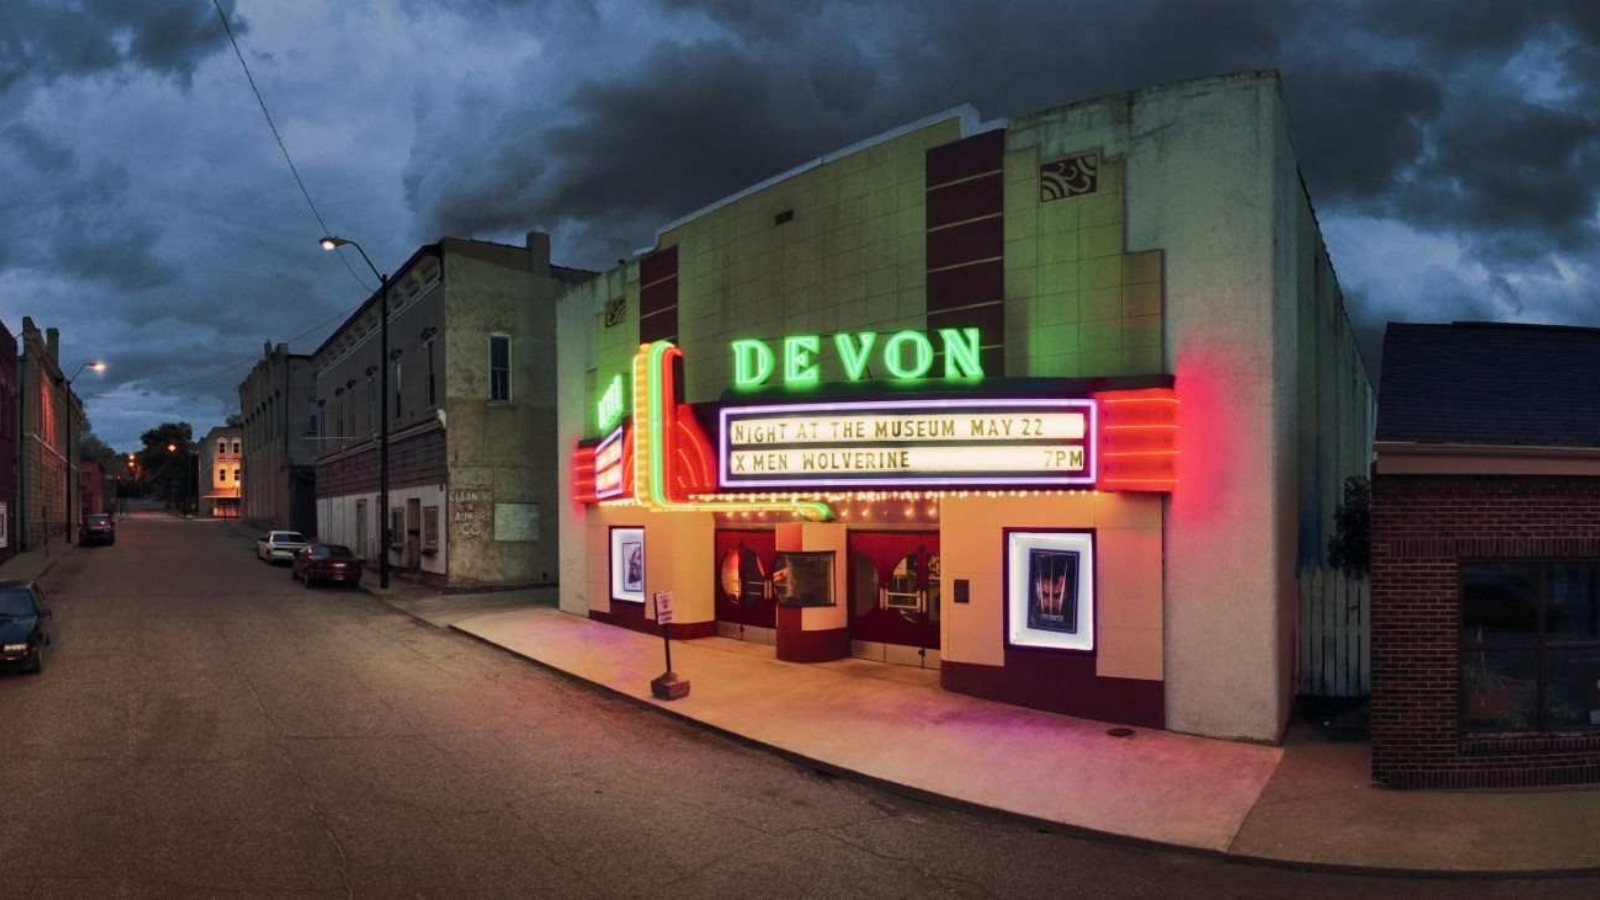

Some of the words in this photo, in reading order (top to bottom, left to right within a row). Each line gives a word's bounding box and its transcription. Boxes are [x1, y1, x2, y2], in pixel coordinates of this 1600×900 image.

[731, 328, 984, 385] DEVON
[735, 424, 787, 443] NIGHT
[797, 422, 819, 439] AT
[830, 421, 865, 438] THE
[875, 420, 956, 438] MUSEUM
[971, 418, 1013, 436] MAY
[1022, 418, 1044, 436] 22
[735, 454, 745, 471] X
[752, 453, 788, 471] MEN
[803, 451, 910, 470] WOLVERINE
[1043, 450, 1083, 468] 7PM
